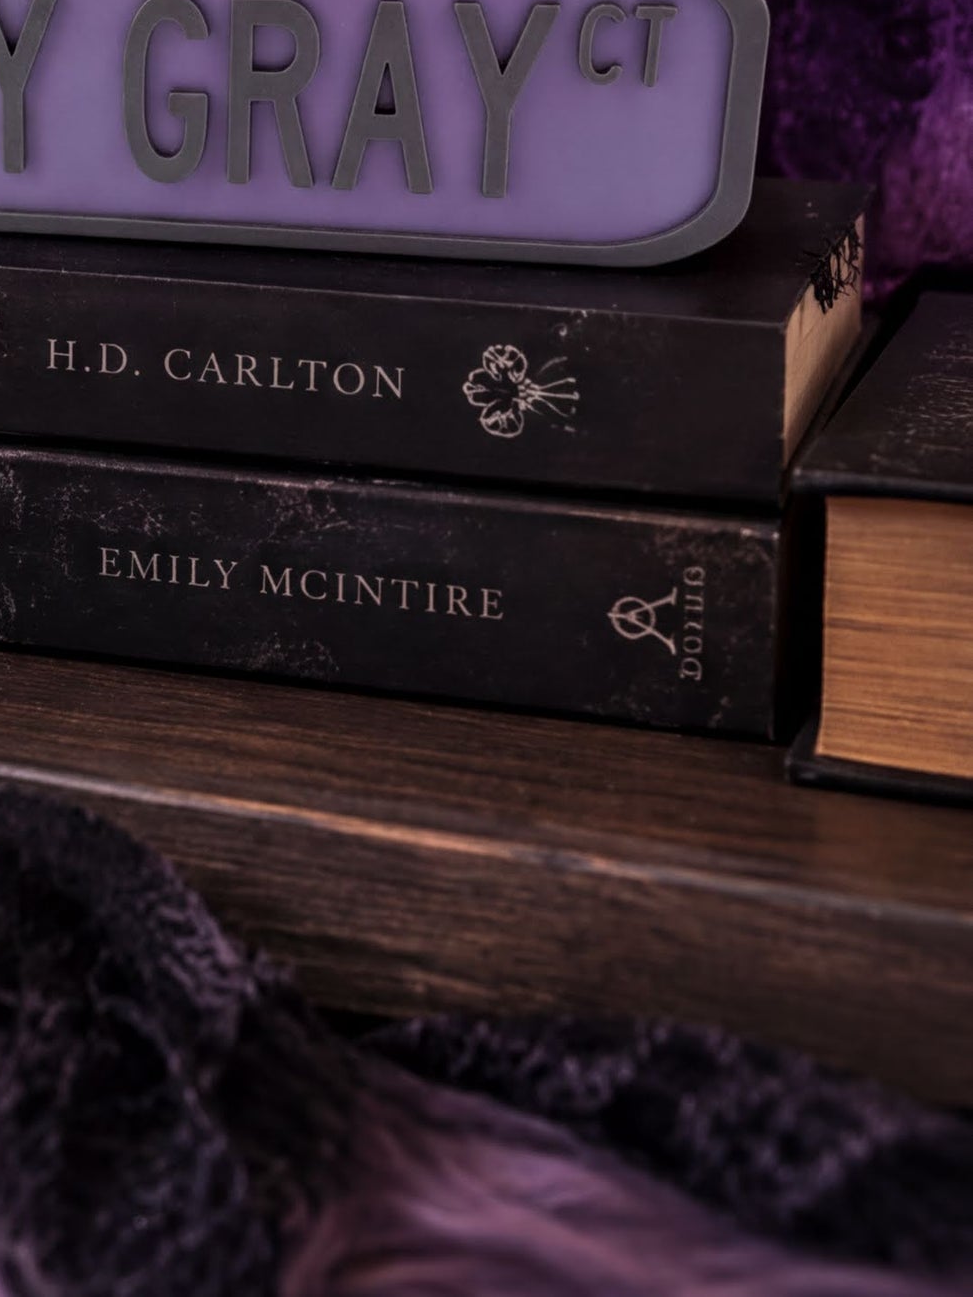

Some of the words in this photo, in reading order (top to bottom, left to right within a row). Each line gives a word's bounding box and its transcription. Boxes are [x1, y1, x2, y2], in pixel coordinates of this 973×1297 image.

[578, 4, 679, 88] CT
[45, 338, 141, 377] H.D.
[163, 348, 405, 400] CARLTON
[98, 547, 239, 591] EMILY
[259, 565, 505, 622] MCINTIRE
